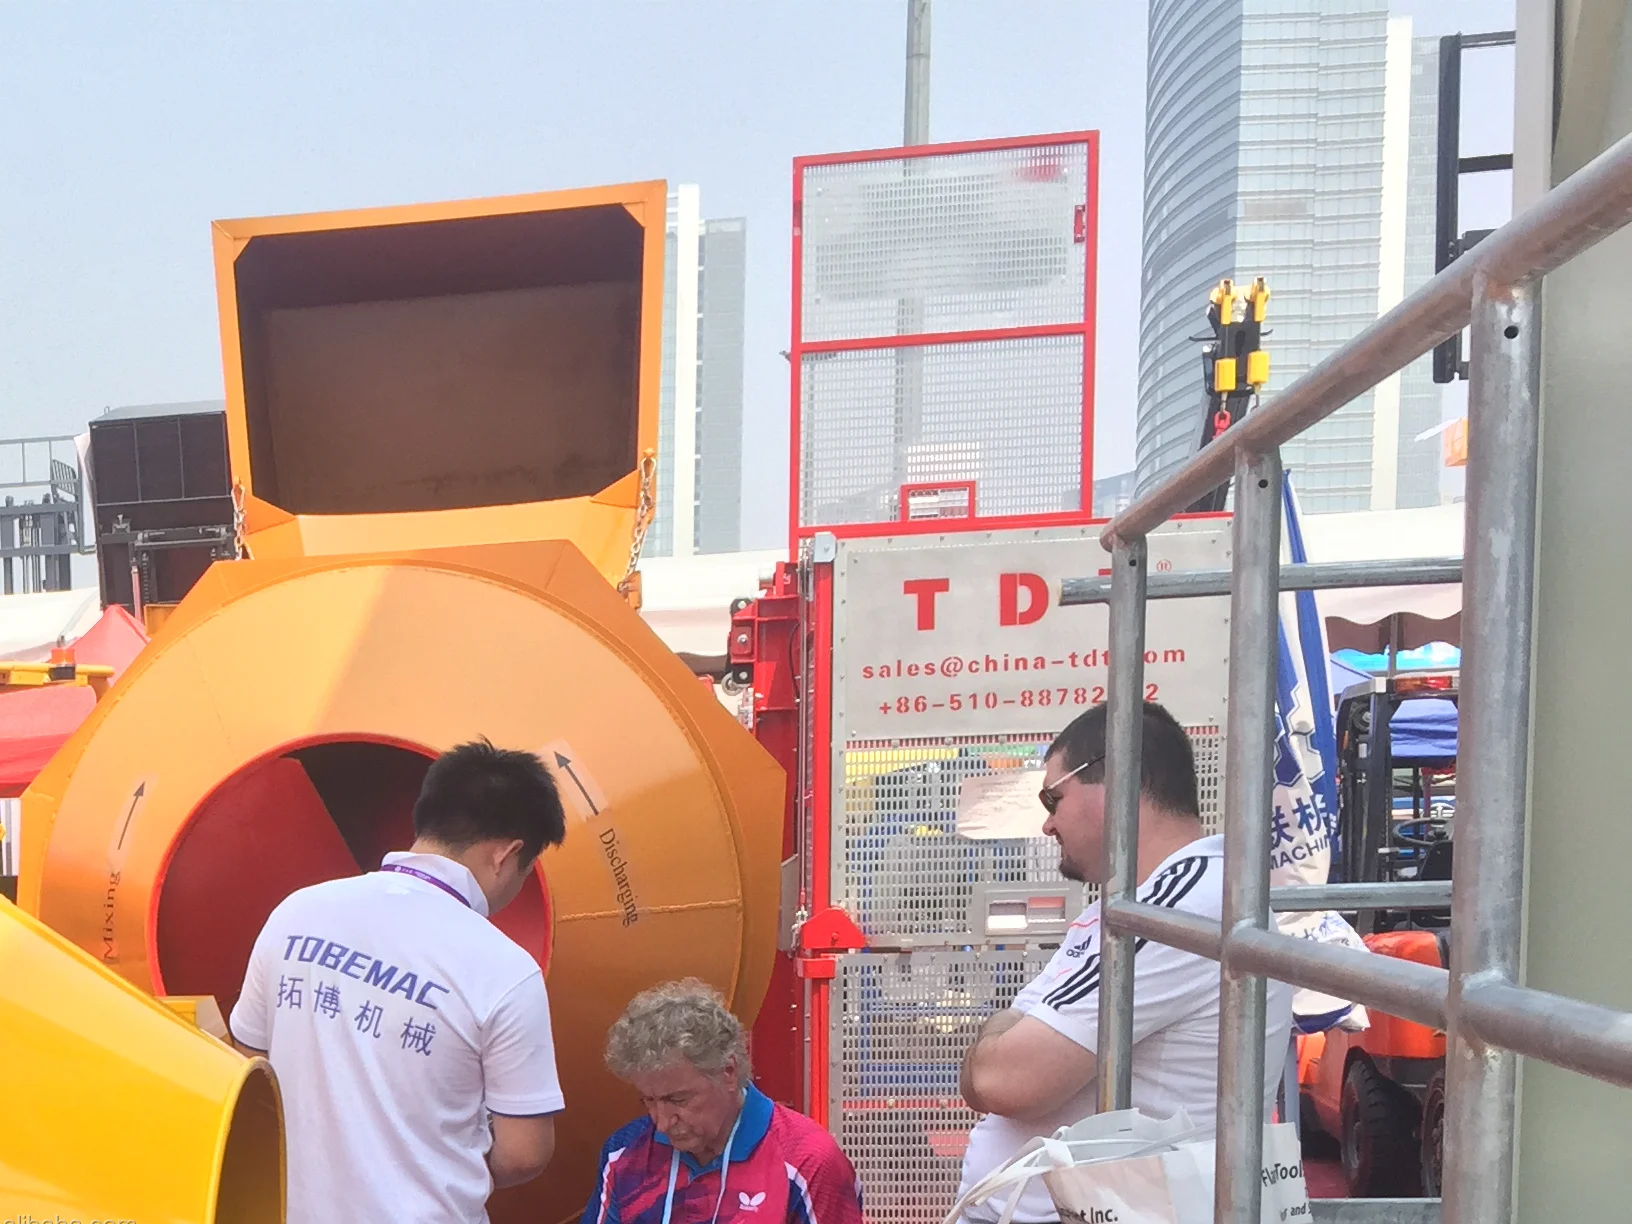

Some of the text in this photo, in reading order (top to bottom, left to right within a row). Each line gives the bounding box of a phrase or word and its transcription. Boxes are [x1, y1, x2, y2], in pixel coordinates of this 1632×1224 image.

[879, 682, 1159, 715] +86-510-887822
[103, 871, 120, 964] Mixing
[599, 828, 638, 928] Discharging
[283, 934, 450, 1010] TOBEMAC
[276, 974, 436, 1056] 拓博机械
[1090, 1207, 1118, 1224] Inc.
